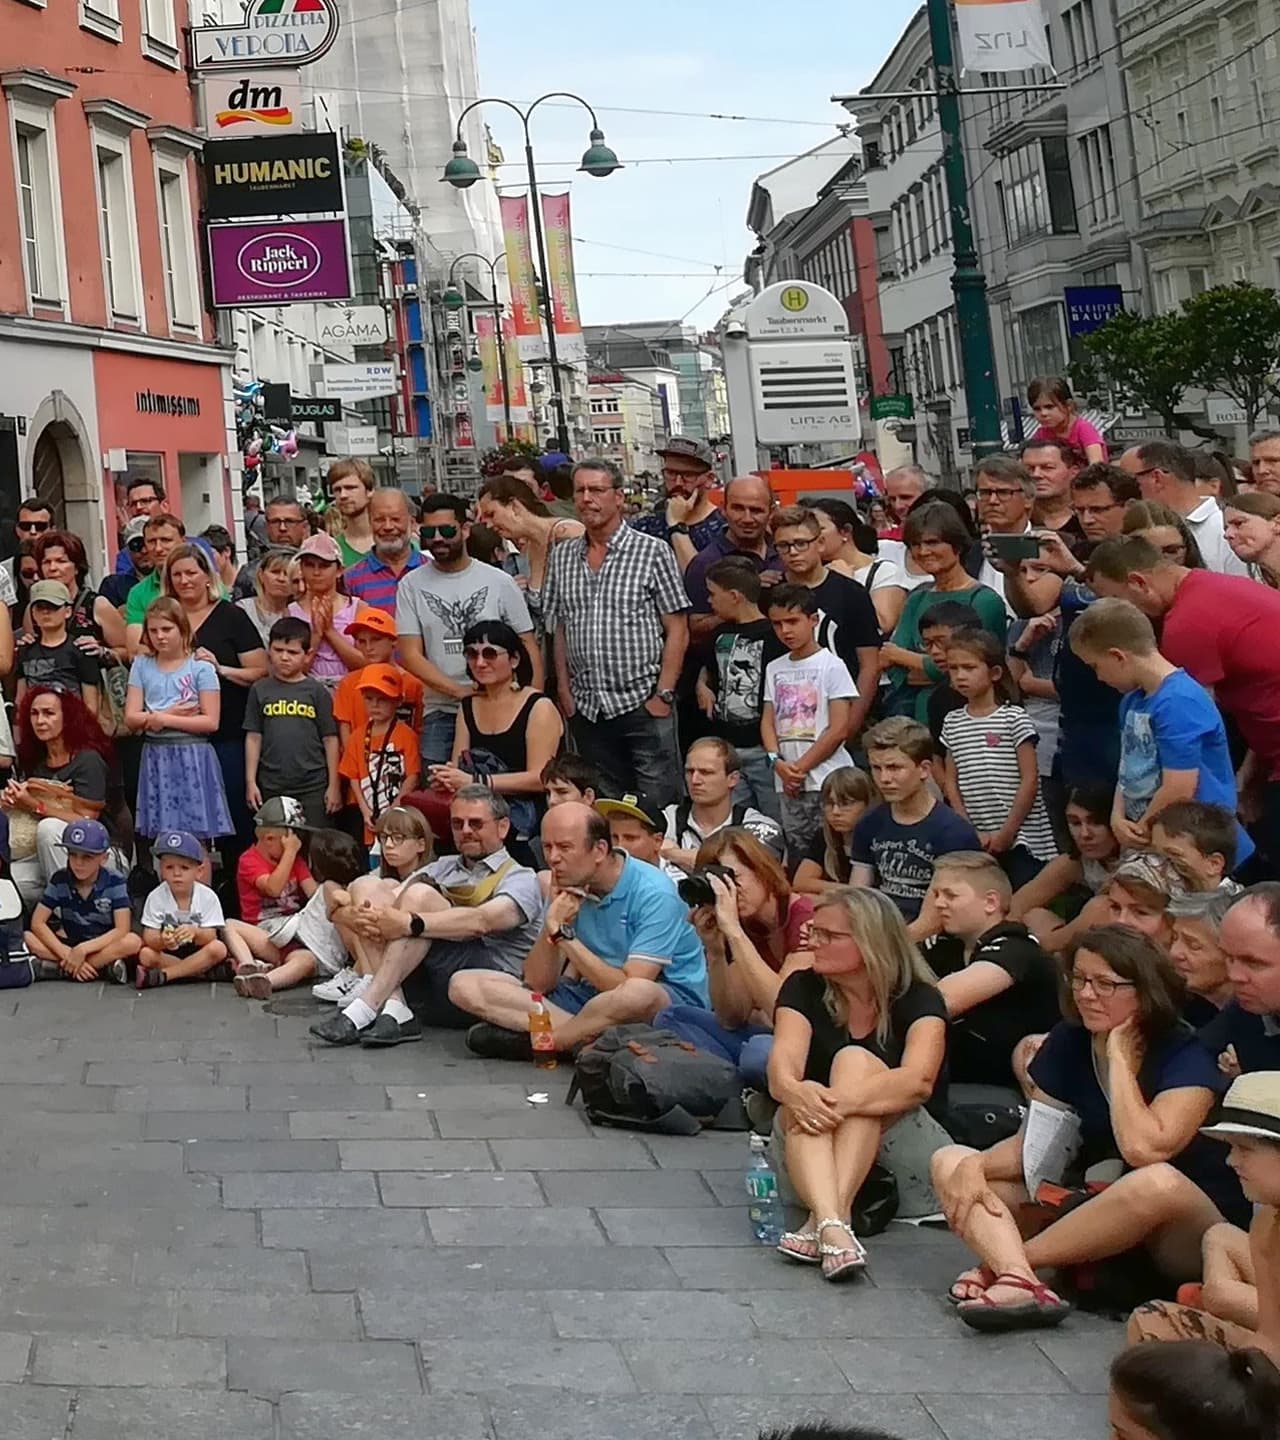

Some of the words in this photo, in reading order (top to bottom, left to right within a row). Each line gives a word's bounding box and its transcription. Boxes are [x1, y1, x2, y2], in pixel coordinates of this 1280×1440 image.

[254, 12, 326, 29] PIZZERIA
[216, 33, 311, 57] VERONA
[228, 79, 282, 110] dm
[214, 157, 332, 185] HUMANIC
[263, 244, 298, 262] Jack
[250, 256, 309, 275] Ripperl
[787, 290, 801, 306] H
[322, 323, 382, 339] AGAMA
[366, 367, 392, 375] RDW
[136, 388, 201, 417] intimissimi
[829, 415, 852, 424] AG
[1116, 429, 1171, 439] APOTHEK
[263, 699, 316, 719] adidas
